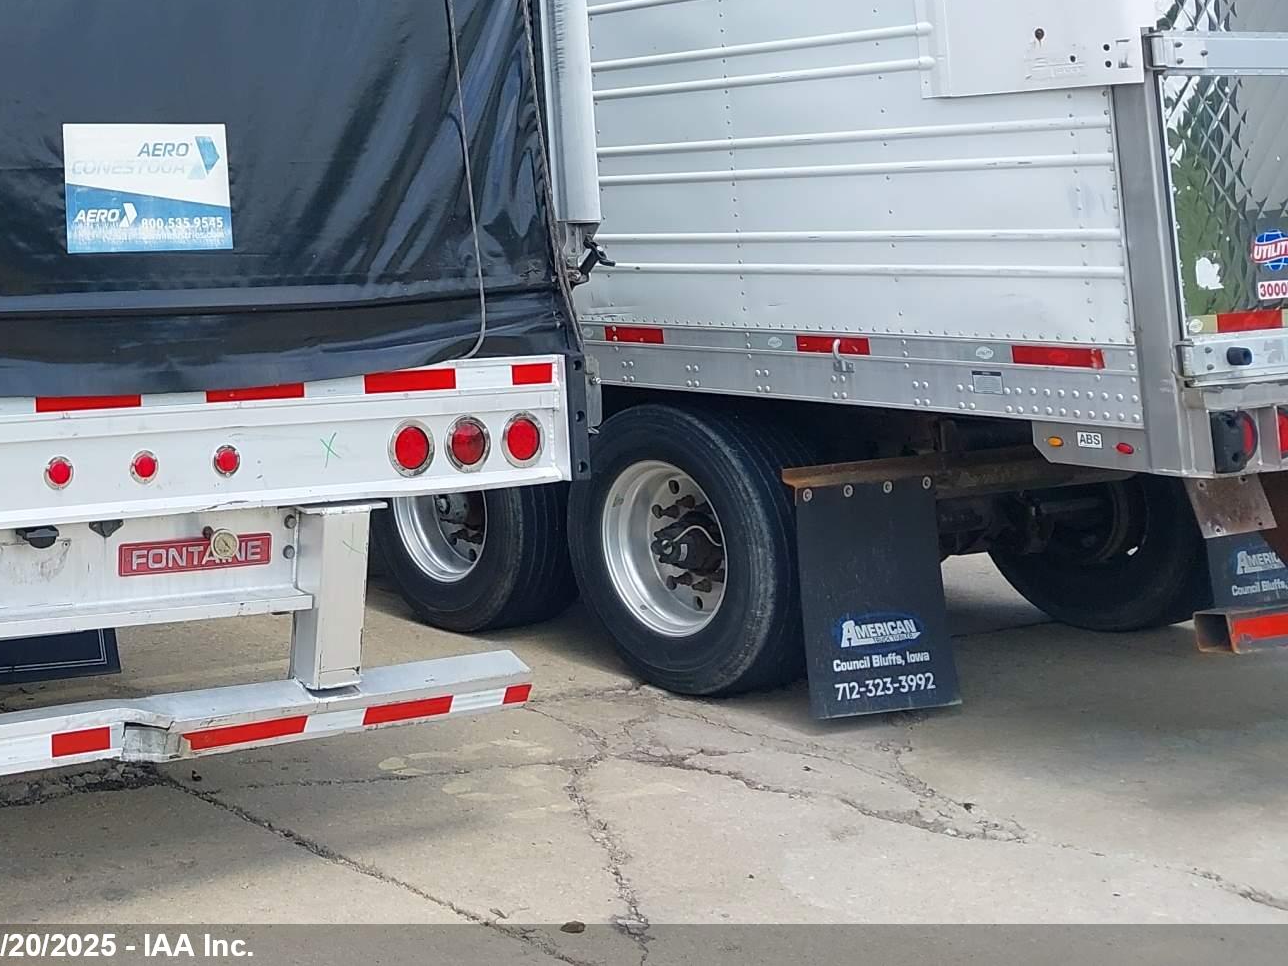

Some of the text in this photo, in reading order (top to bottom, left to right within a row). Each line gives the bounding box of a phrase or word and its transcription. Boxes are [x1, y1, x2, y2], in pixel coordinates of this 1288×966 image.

[137, 142, 189, 157] AERO
[73, 208, 119, 223] AERO
[1079, 434, 1101, 446] ABS
[132, 540, 262, 570] FONTANE
[841, 619, 917, 647] AMERICAN
[833, 651, 930, 672] Council Bluffs, Iowa
[835, 672, 935, 701] 712-323-3992
